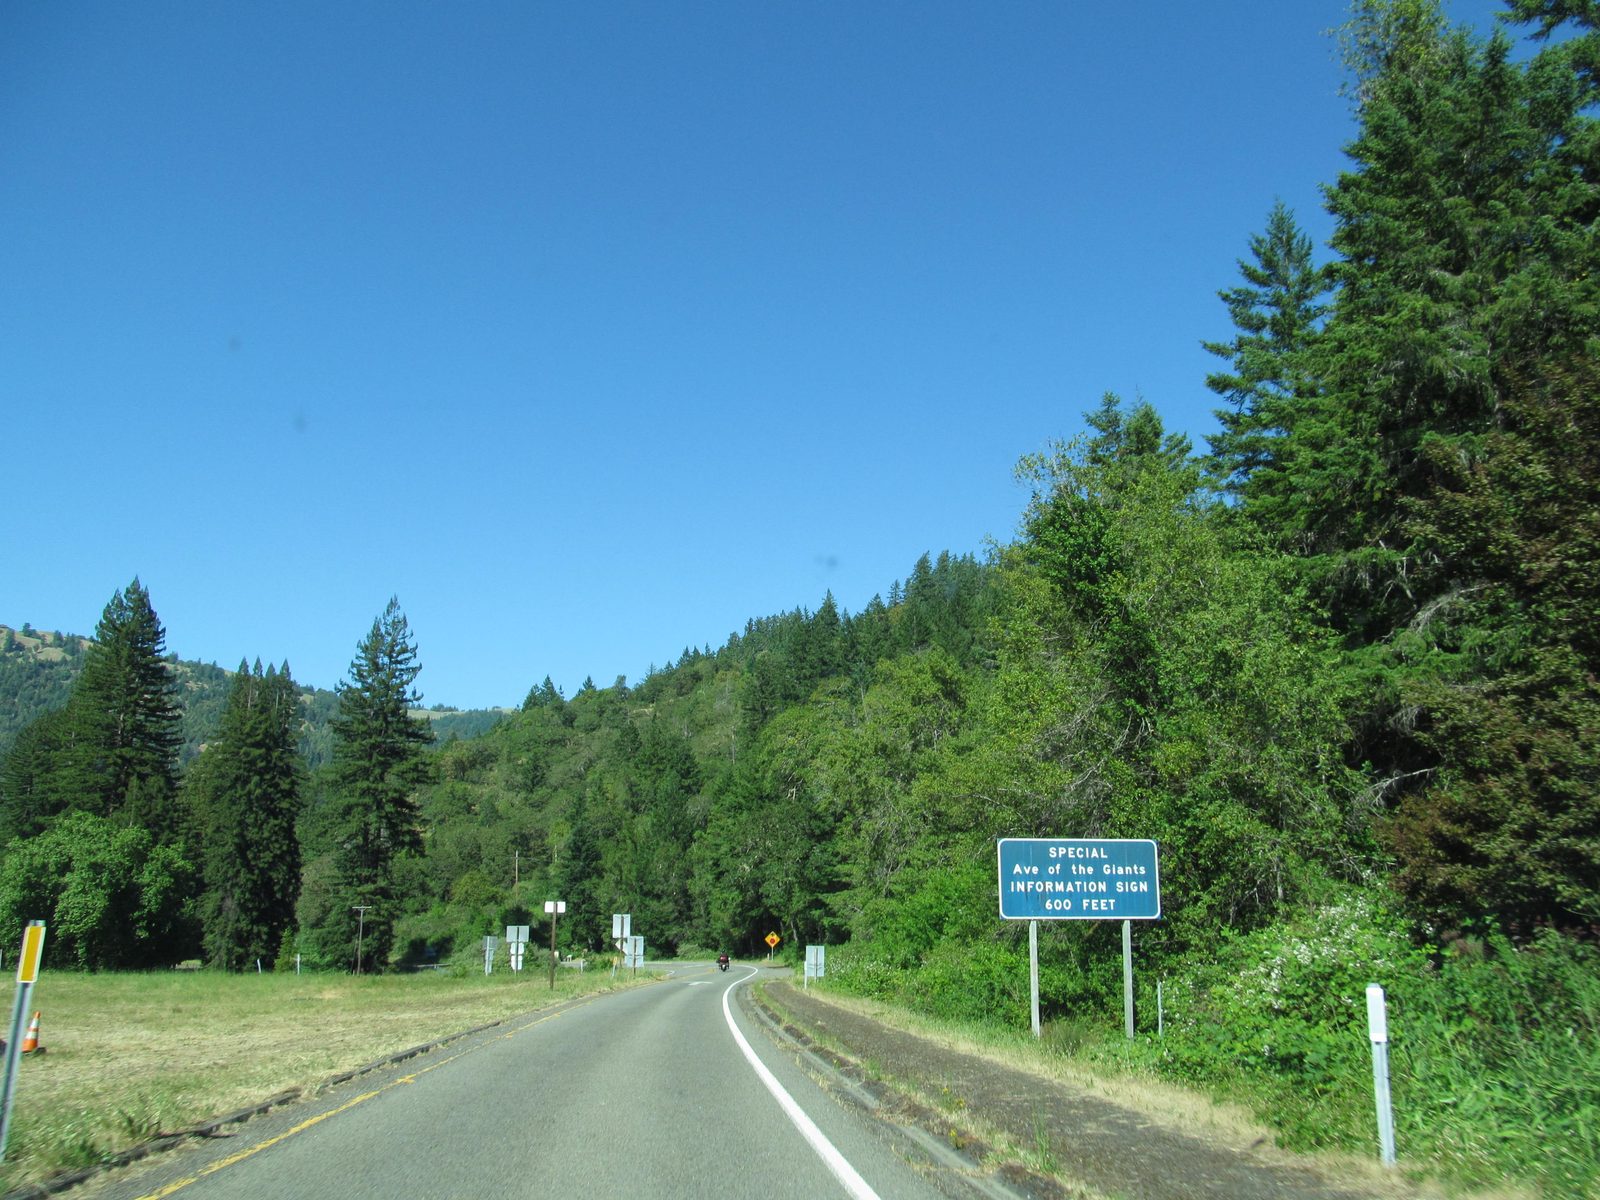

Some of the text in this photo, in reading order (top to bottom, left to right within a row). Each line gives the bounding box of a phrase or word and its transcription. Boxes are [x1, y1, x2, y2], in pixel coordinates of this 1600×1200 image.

[1049, 847, 1108, 858] SPECIAL
[1013, 864, 1039, 875] Ave
[1048, 863, 1061, 875] of
[1071, 864, 1094, 875] the
[1011, 881, 1148, 892] INFORMATION SIGN
[1045, 899, 1116, 910] 600 FEET
